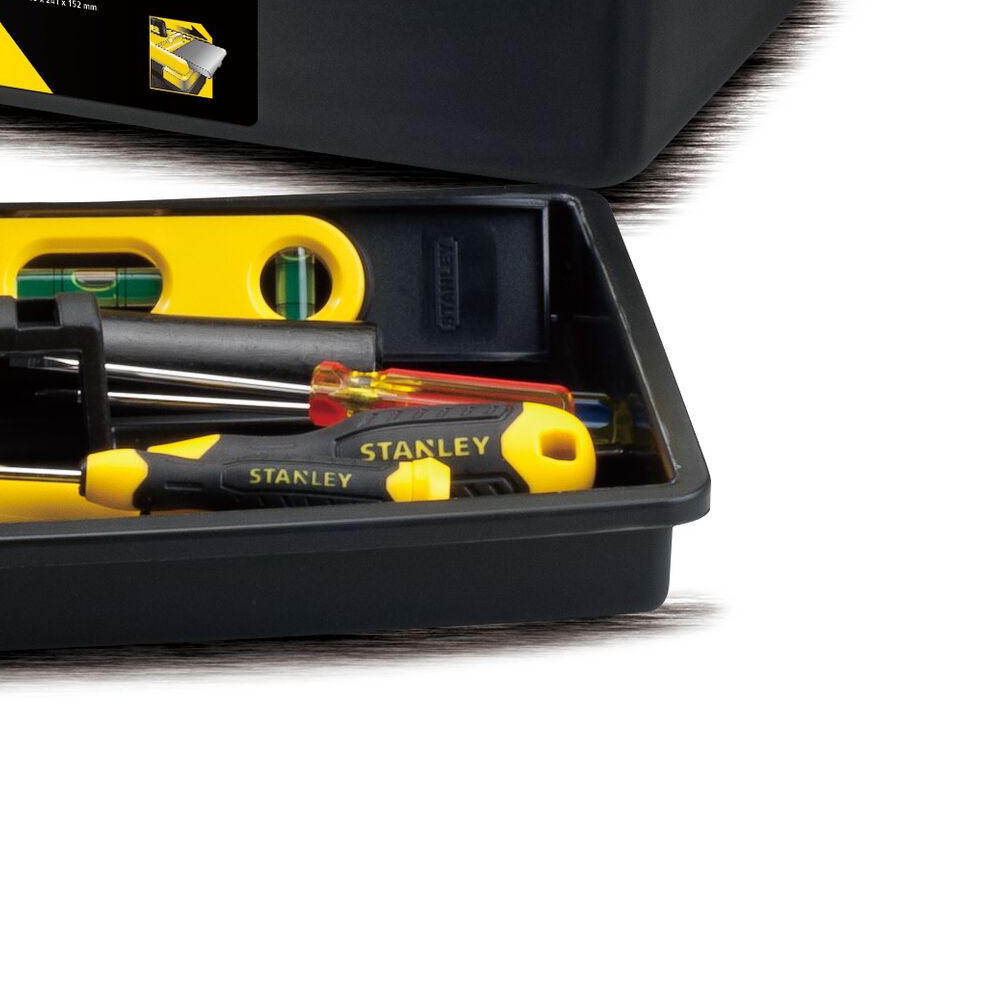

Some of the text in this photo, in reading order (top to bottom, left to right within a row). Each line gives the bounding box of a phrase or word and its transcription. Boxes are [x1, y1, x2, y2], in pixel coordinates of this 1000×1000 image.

[68, 0, 82, 9] 152
[82, 3, 98, 12] mm
[360, 436, 490, 462] STANLEY
[249, 468, 352, 489] STANLEY
